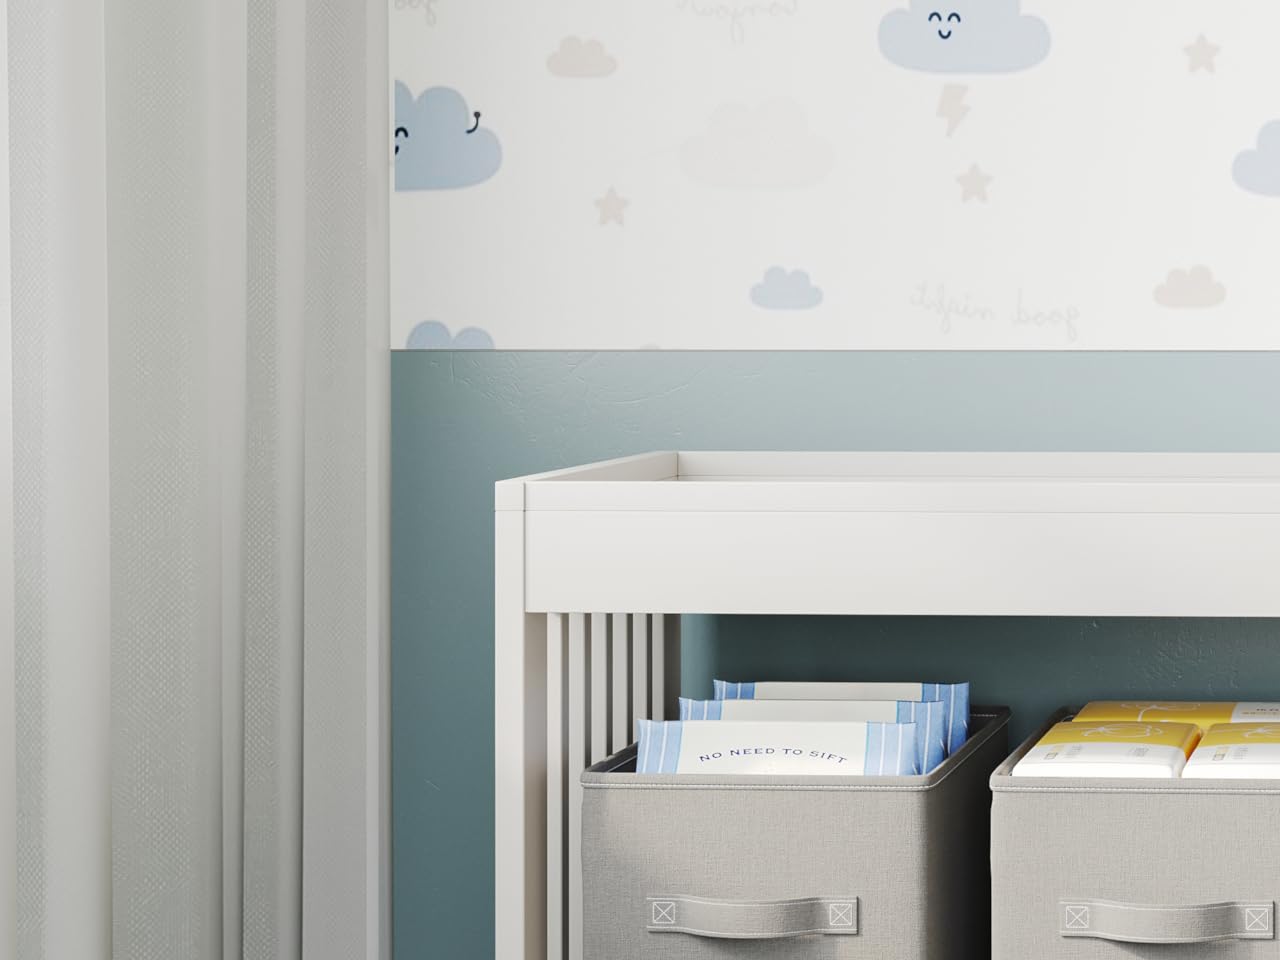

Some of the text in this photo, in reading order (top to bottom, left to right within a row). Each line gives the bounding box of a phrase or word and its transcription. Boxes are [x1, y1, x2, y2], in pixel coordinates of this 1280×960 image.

[699, 748, 848, 764] NO NEED TO SIFT
